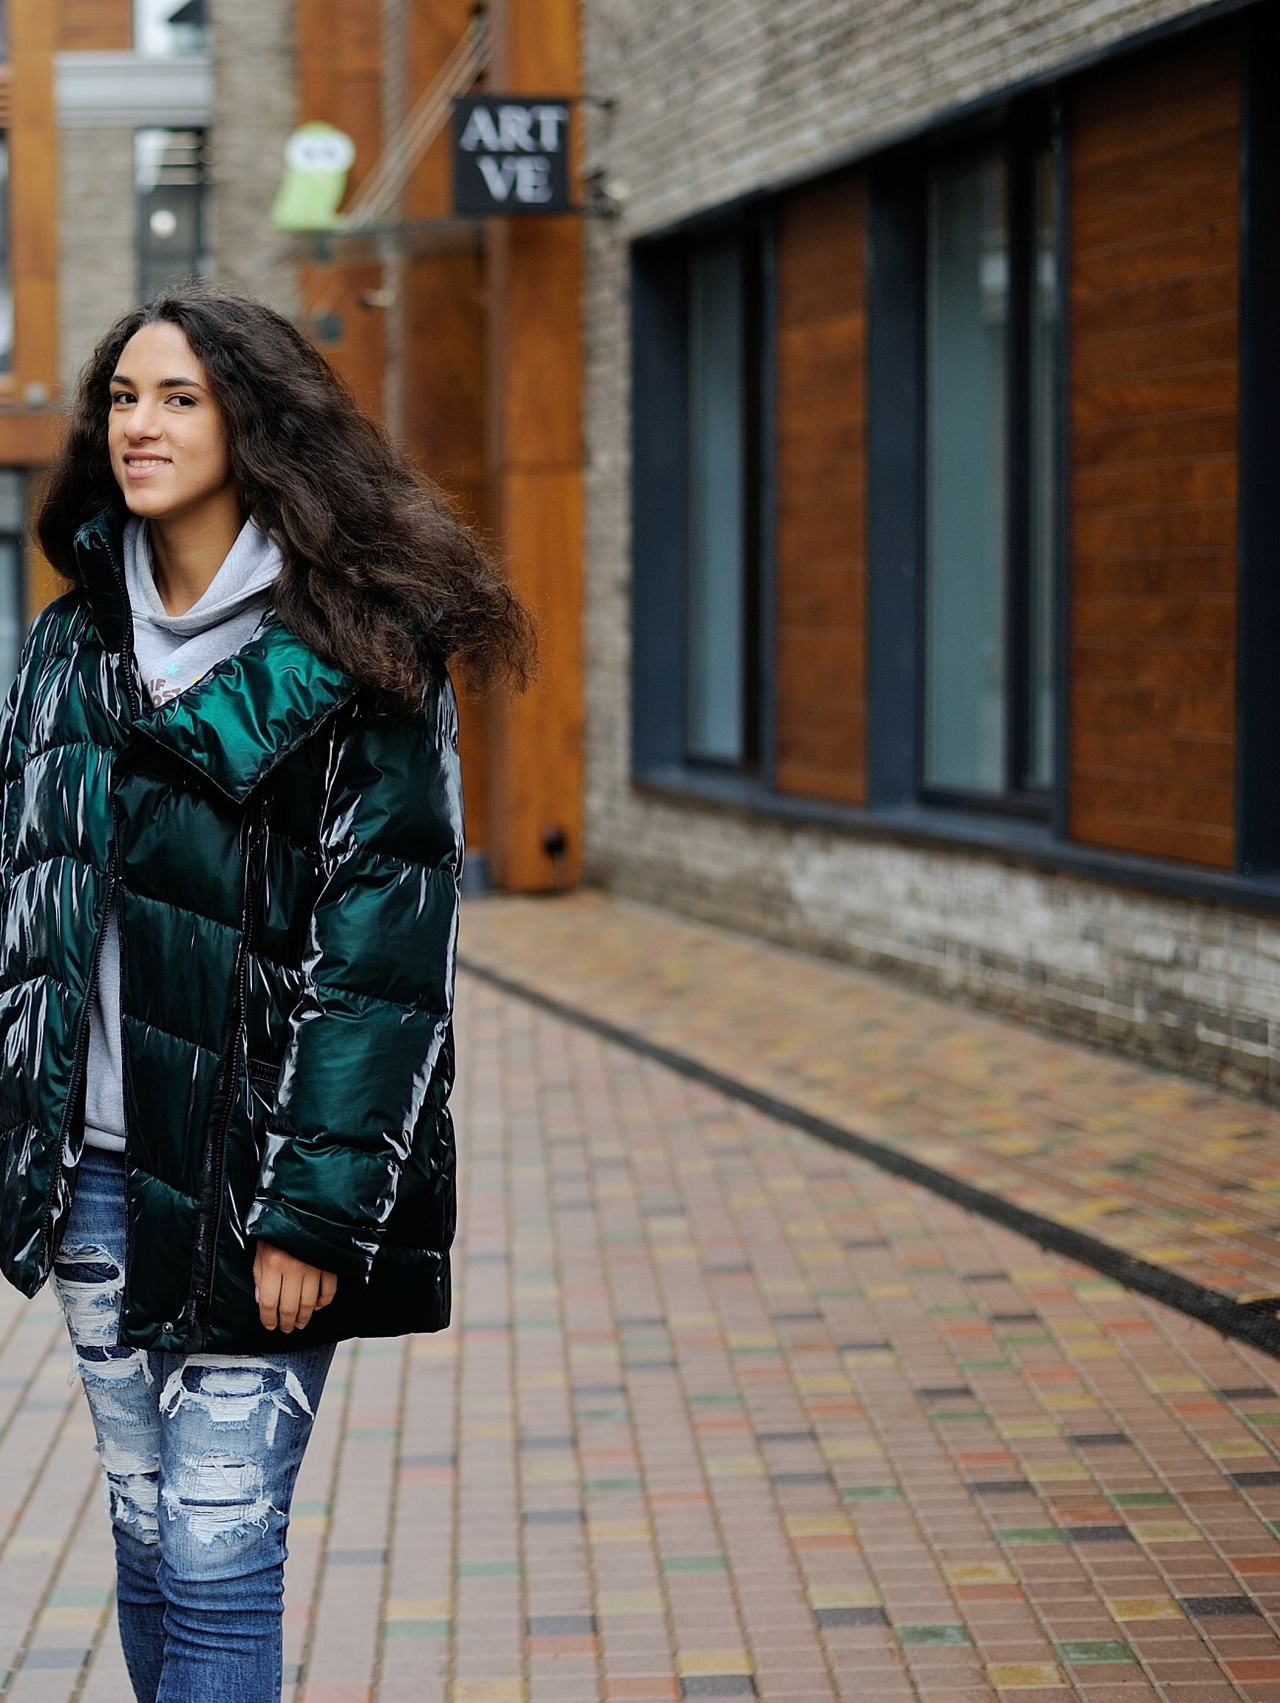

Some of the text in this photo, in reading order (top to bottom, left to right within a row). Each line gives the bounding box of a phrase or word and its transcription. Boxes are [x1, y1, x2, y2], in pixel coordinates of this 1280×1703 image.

[460, 105, 569, 152] ART
[477, 155, 553, 203] VE
[150, 678, 166, 692] IF
